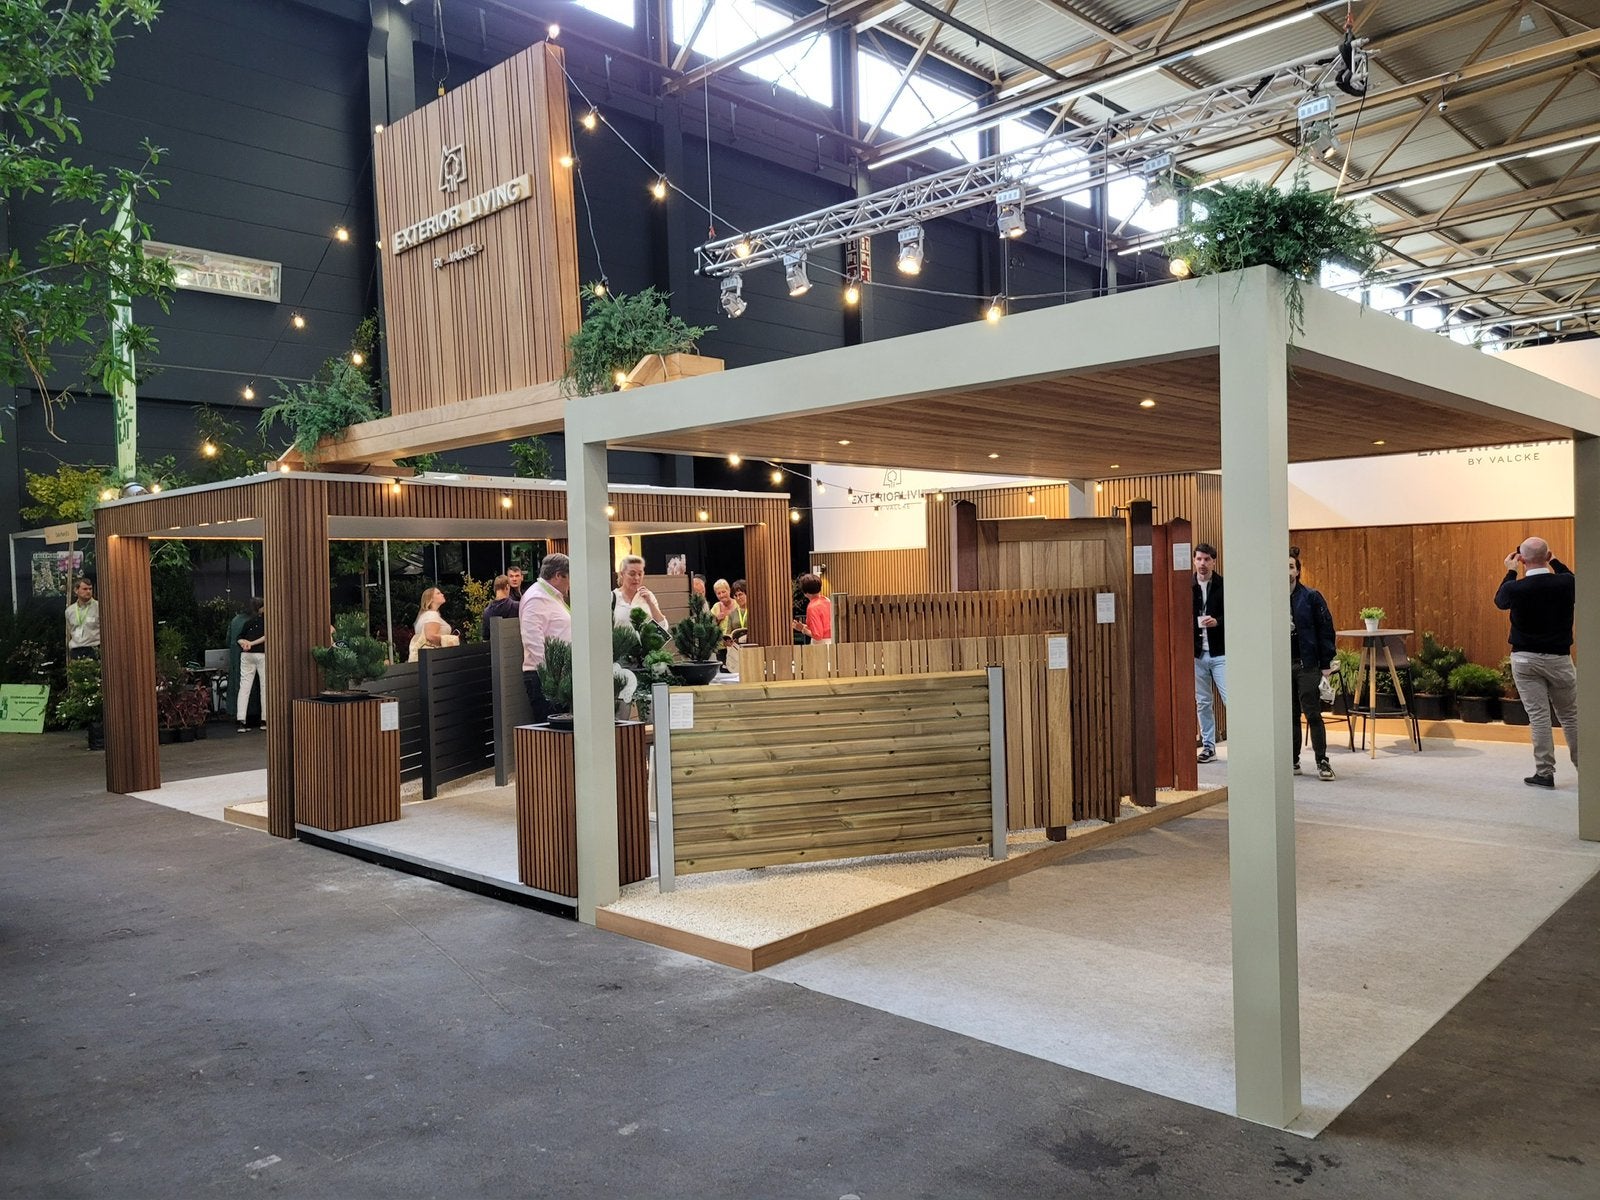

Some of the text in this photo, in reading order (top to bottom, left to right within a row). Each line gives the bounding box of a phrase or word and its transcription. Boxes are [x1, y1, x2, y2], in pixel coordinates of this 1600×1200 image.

[395, 182, 521, 250] EXTERIOR LIVING
[1468, 452, 1541, 466] BY VALCKE
